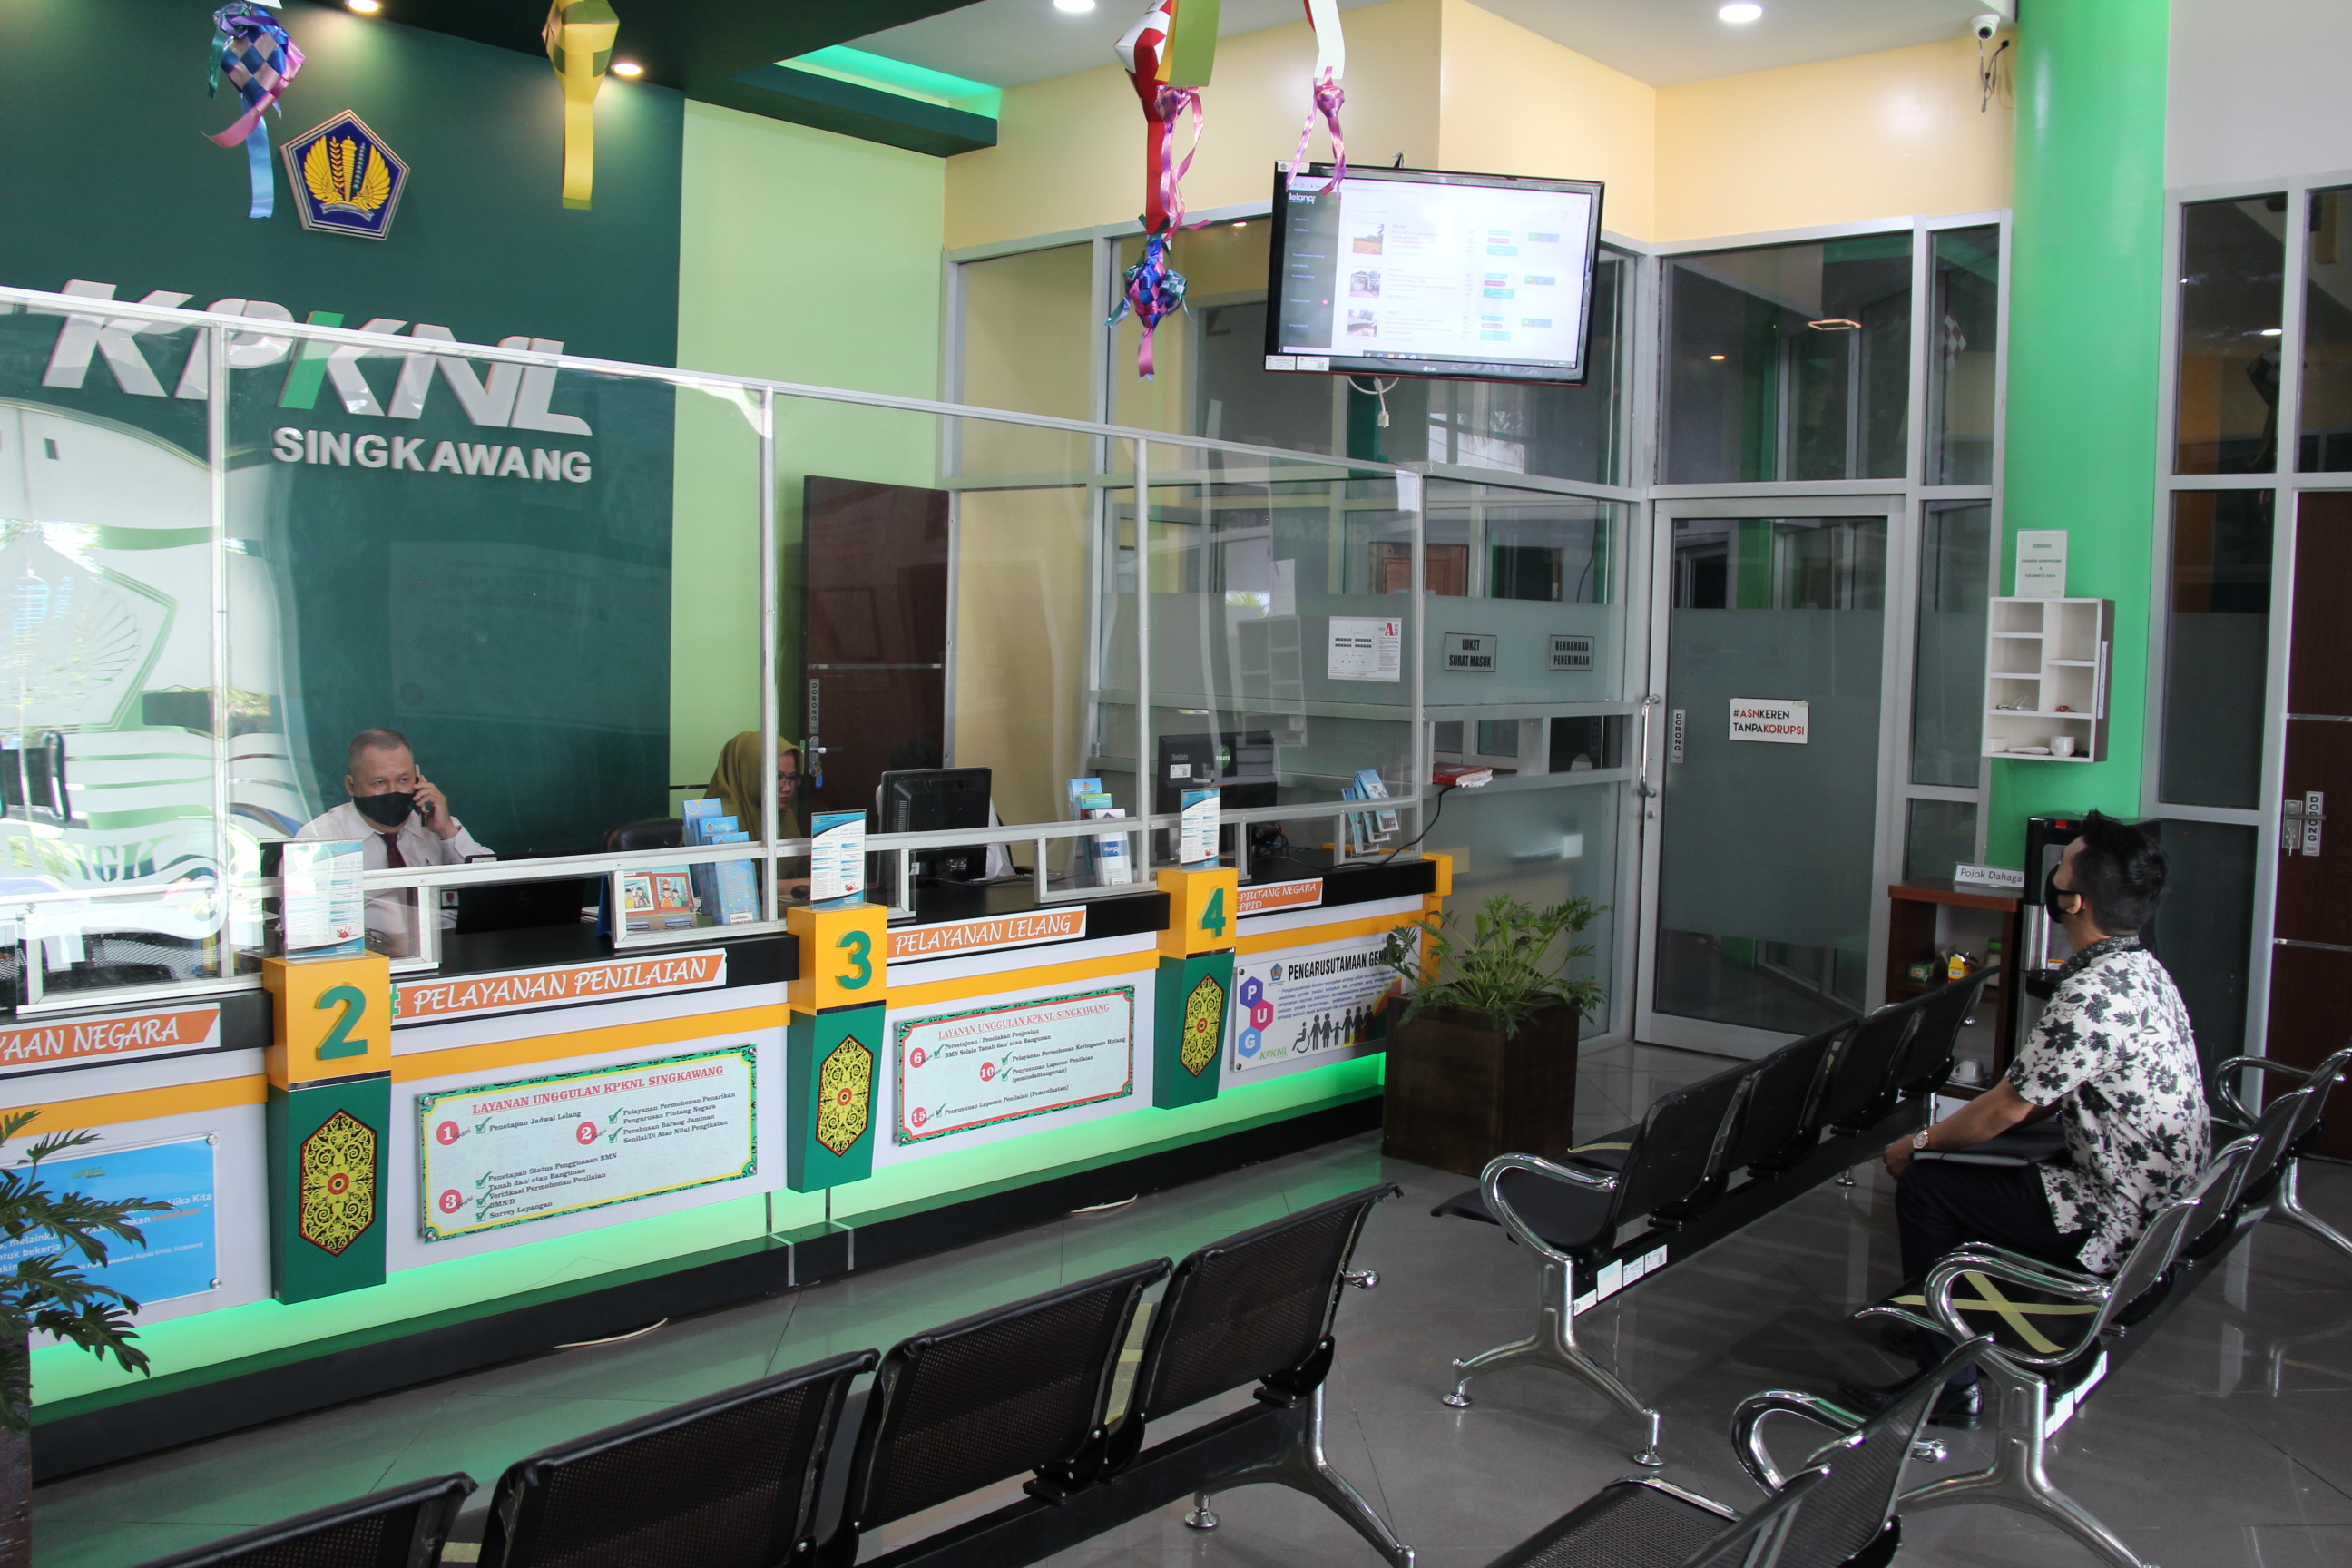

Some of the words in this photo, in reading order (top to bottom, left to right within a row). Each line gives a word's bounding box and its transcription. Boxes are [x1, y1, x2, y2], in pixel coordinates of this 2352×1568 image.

[41, 279, 592, 436] KPKNL
[273, 426, 592, 484] SINGKAWANG
[1462, 639, 1481, 651] LOKET
[1555, 641, 1589, 652] BENDAHARA
[1449, 655, 1469, 666] SURAT
[1470, 656, 1492, 667] MASUK
[1553, 655, 1589, 665] PENERIMAAN
[1733, 709, 1789, 720] #ASNKEREN
[1733, 722, 1805, 735] TANPAKORUPSI
[1961, 868, 1985, 878] Pojok
[1989, 871, 2022, 884] Dahaga
[1282, 883, 1316, 896] NEGARA
[1199, 887, 1226, 937] 4
[896, 923, 1002, 956] PELAYANAN
[1007, 914, 1073, 939] LELANG
[835, 929, 872, 990] 3
[1289, 953, 1367, 981] PENGARUSUTAMAAN
[413, 974, 568, 1014] PELAYANAN
[573, 957, 707, 992] PENILAIAN
[1248, 985, 1258, 1000] P
[315, 985, 368, 1061] 2
[938, 1028, 975, 1039] LAYANAN
[978, 1020, 1024, 1032] UNGGULAN
[1027, 1014, 1055, 1024] KPKNL
[1056, 1004, 1110, 1019] SINGKAWANG
[1257, 1008, 1268, 1023] U
[73, 1015, 180, 1054] NEGARA
[1244, 1034, 1256, 1048] G
[914, 1052, 922, 1063] 6
[1012, 1052, 1040, 1062] Pelayanan
[1259, 1047, 1288, 1060] KPKNL
[1046, 1059, 1068, 1069] Laporan
[981, 1067, 995, 1078] 10
[472, 1096, 529, 1114] LAYANAN
[534, 1085, 601, 1104] UNGGULAN
[604, 1079, 645, 1093] KPKNL
[649, 1066, 724, 1085] SINGKAWANG
[622, 1105, 659, 1116] Pelayanan
[660, 1098, 701, 1110] Permohonan
[702, 1092, 735, 1102] Penarikan
[945, 1103, 978, 1115] Penyusunan
[979, 1099, 1002, 1109] Laporan
[1004, 1093, 1028, 1102] Penilaian
[489, 1120, 528, 1132] Penetapan
[530, 1115, 556, 1125] Jadwal
[557, 1111, 582, 1121] Lelang
[623, 1112, 664, 1125] Pengurusan
[665, 1109, 691, 1117] Piutang
[693, 1103, 716, 1113] Negara
[912, 1111, 926, 1122] 15
[622, 1123, 659, 1134] Penebusan
[661, 1119, 685, 1128] Barang
[687, 1114, 714, 1123] Jaminan
[691, 1120, 728, 1132] Pengikatan
[443, 1127, 454, 1141] 1
[581, 1127, 592, 1140] 2
[488, 1170, 527, 1181] Penetapan
[529, 1165, 553, 1174] Status
[554, 1157, 598, 1170] Penggunaan
[600, 1152, 617, 1161] BMN
[489, 1181, 512, 1191] Tanah
[550, 1168, 586, 1180] Bangunan
[489, 1188, 524, 1200] Verifikasi
[526, 1180, 572, 1192] Permohonan
[573, 1172, 606, 1183] Penilaian
[192, 1193, 211, 1202] Kita
[446, 1195, 457, 1209] 3
[152, 1208, 201, 1221] komitmen
[489, 1209, 515, 1219] Survey
[517, 1200, 553, 1213] Lapangan
[23, 1242, 60, 1257] bekerja
